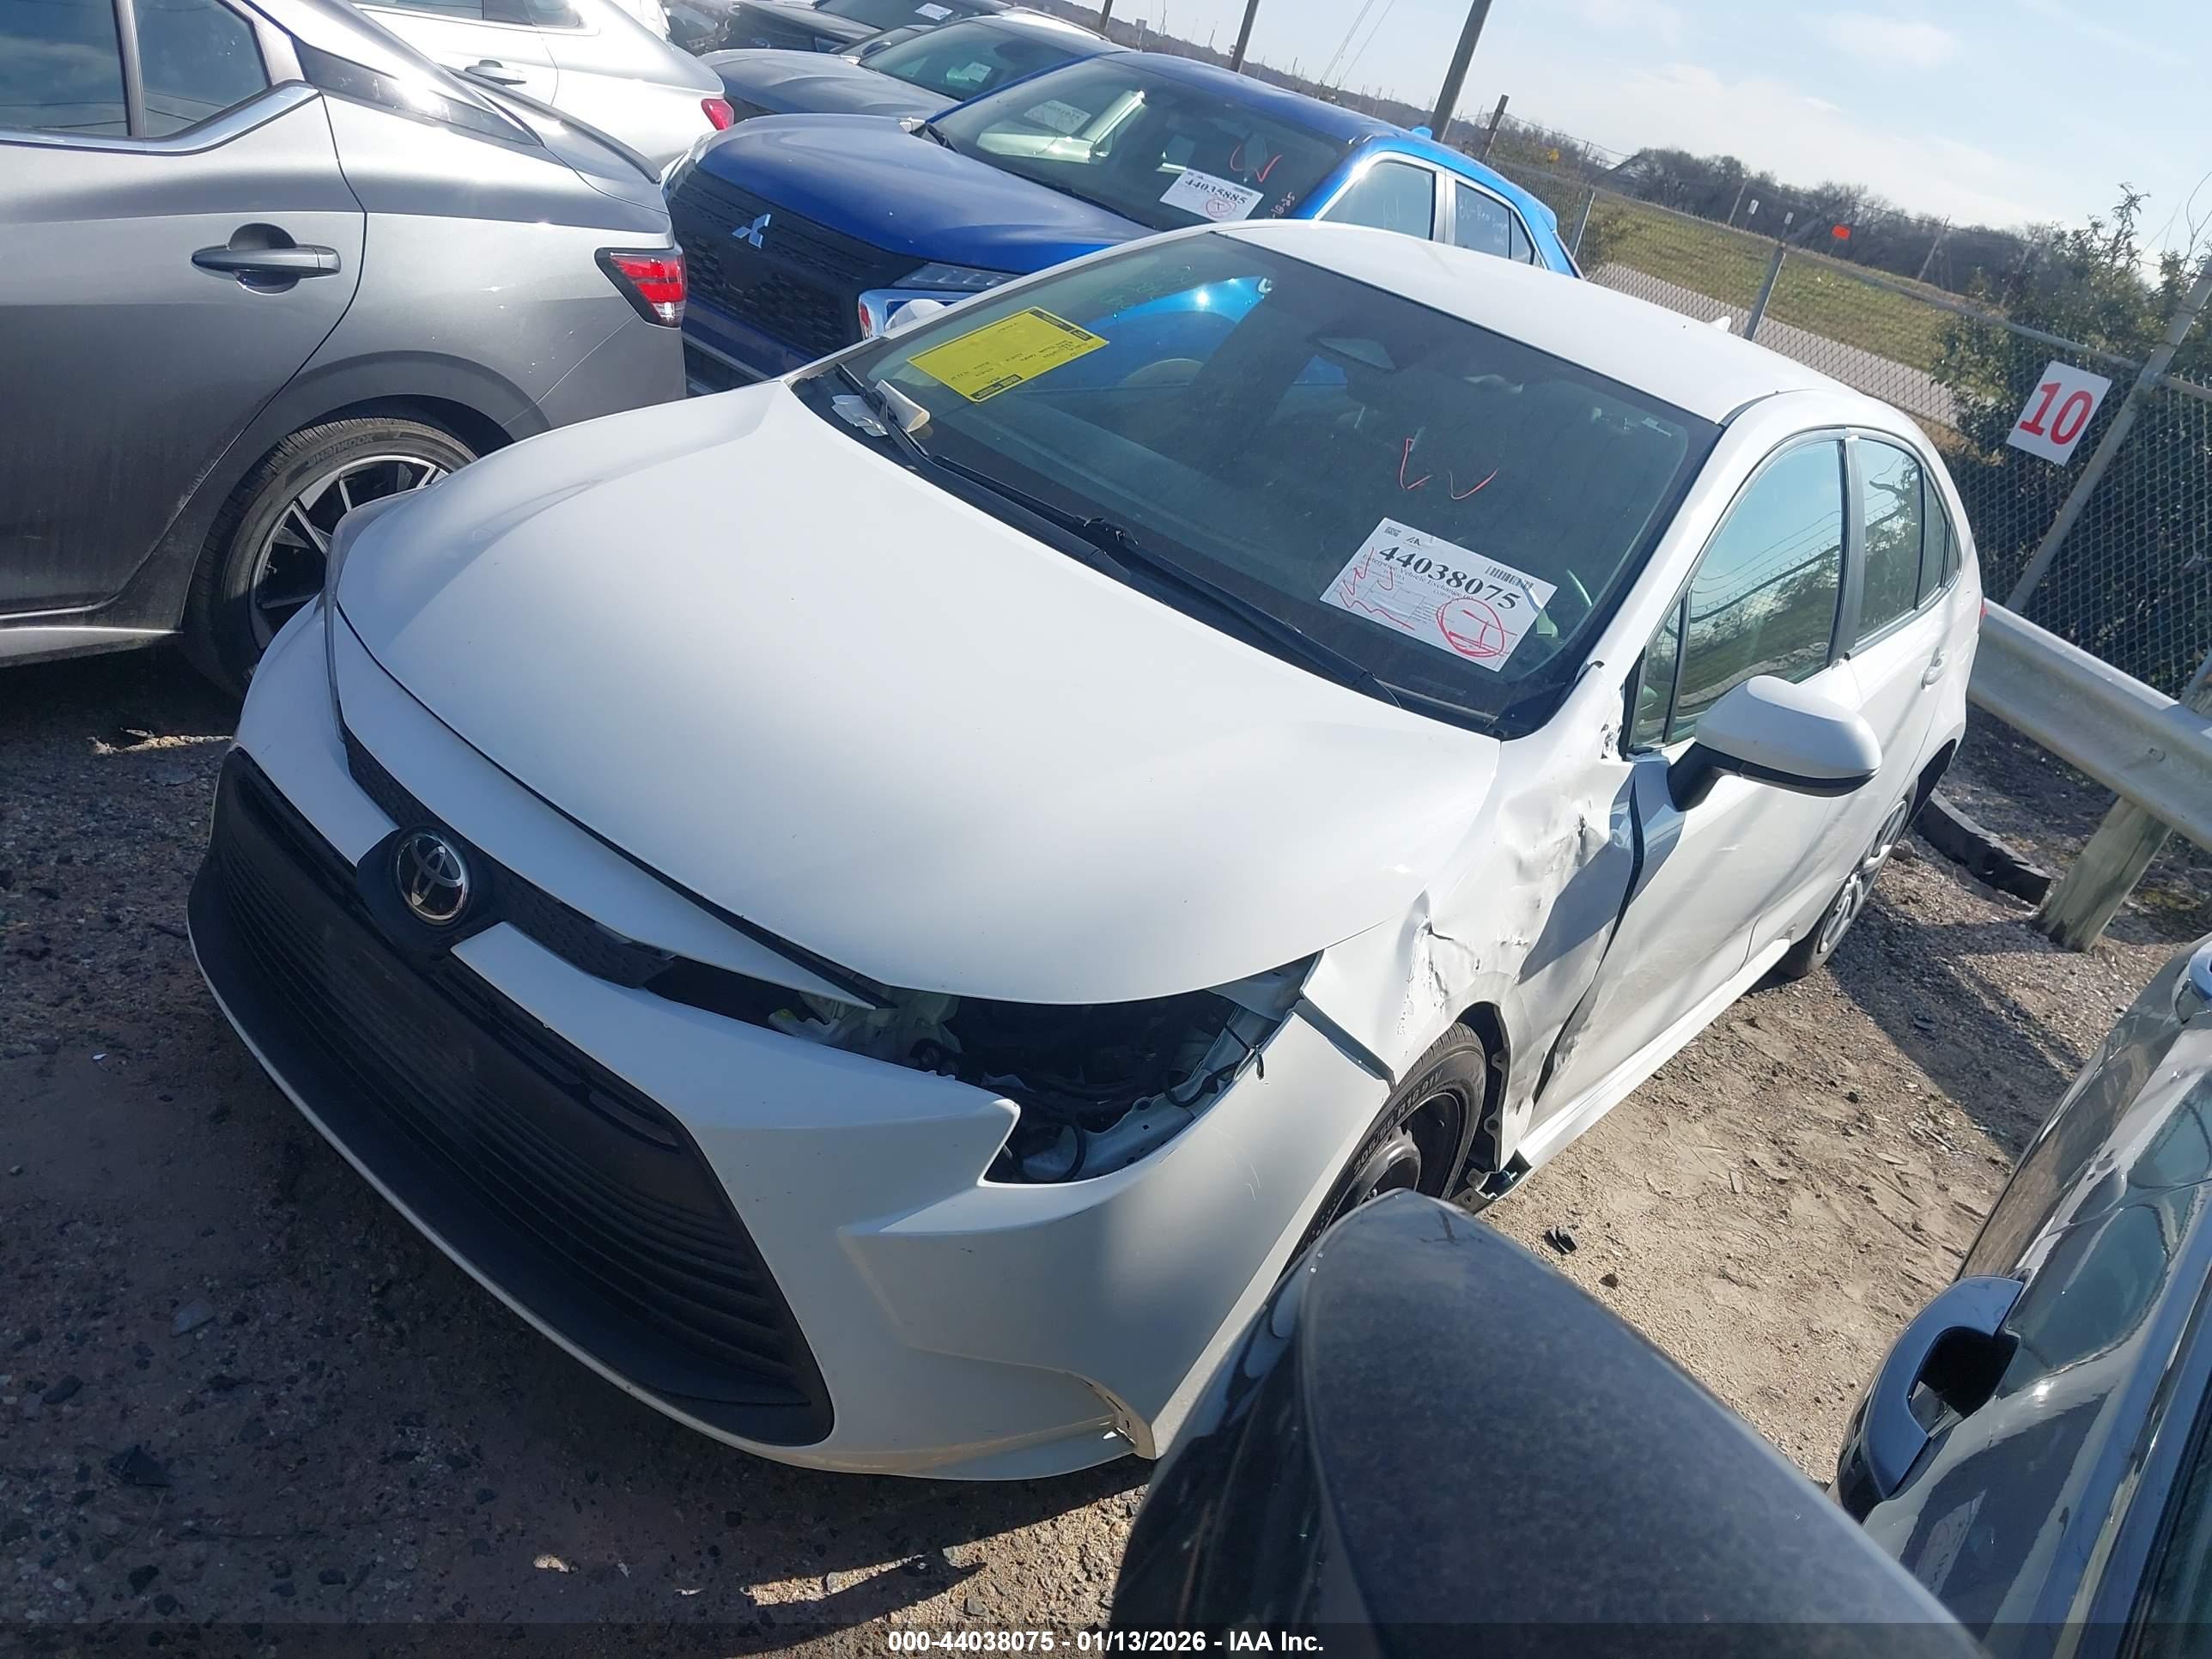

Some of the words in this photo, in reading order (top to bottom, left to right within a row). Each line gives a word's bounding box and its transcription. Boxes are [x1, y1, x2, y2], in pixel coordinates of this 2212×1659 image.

[2019, 381, 2094, 445] 10
[1378, 545, 1522, 611] 44038075
[1352, 1116, 1395, 1176] 205/55
[1395, 1088, 1421, 1115] R16
[1420, 1068, 1443, 1097] 91V
